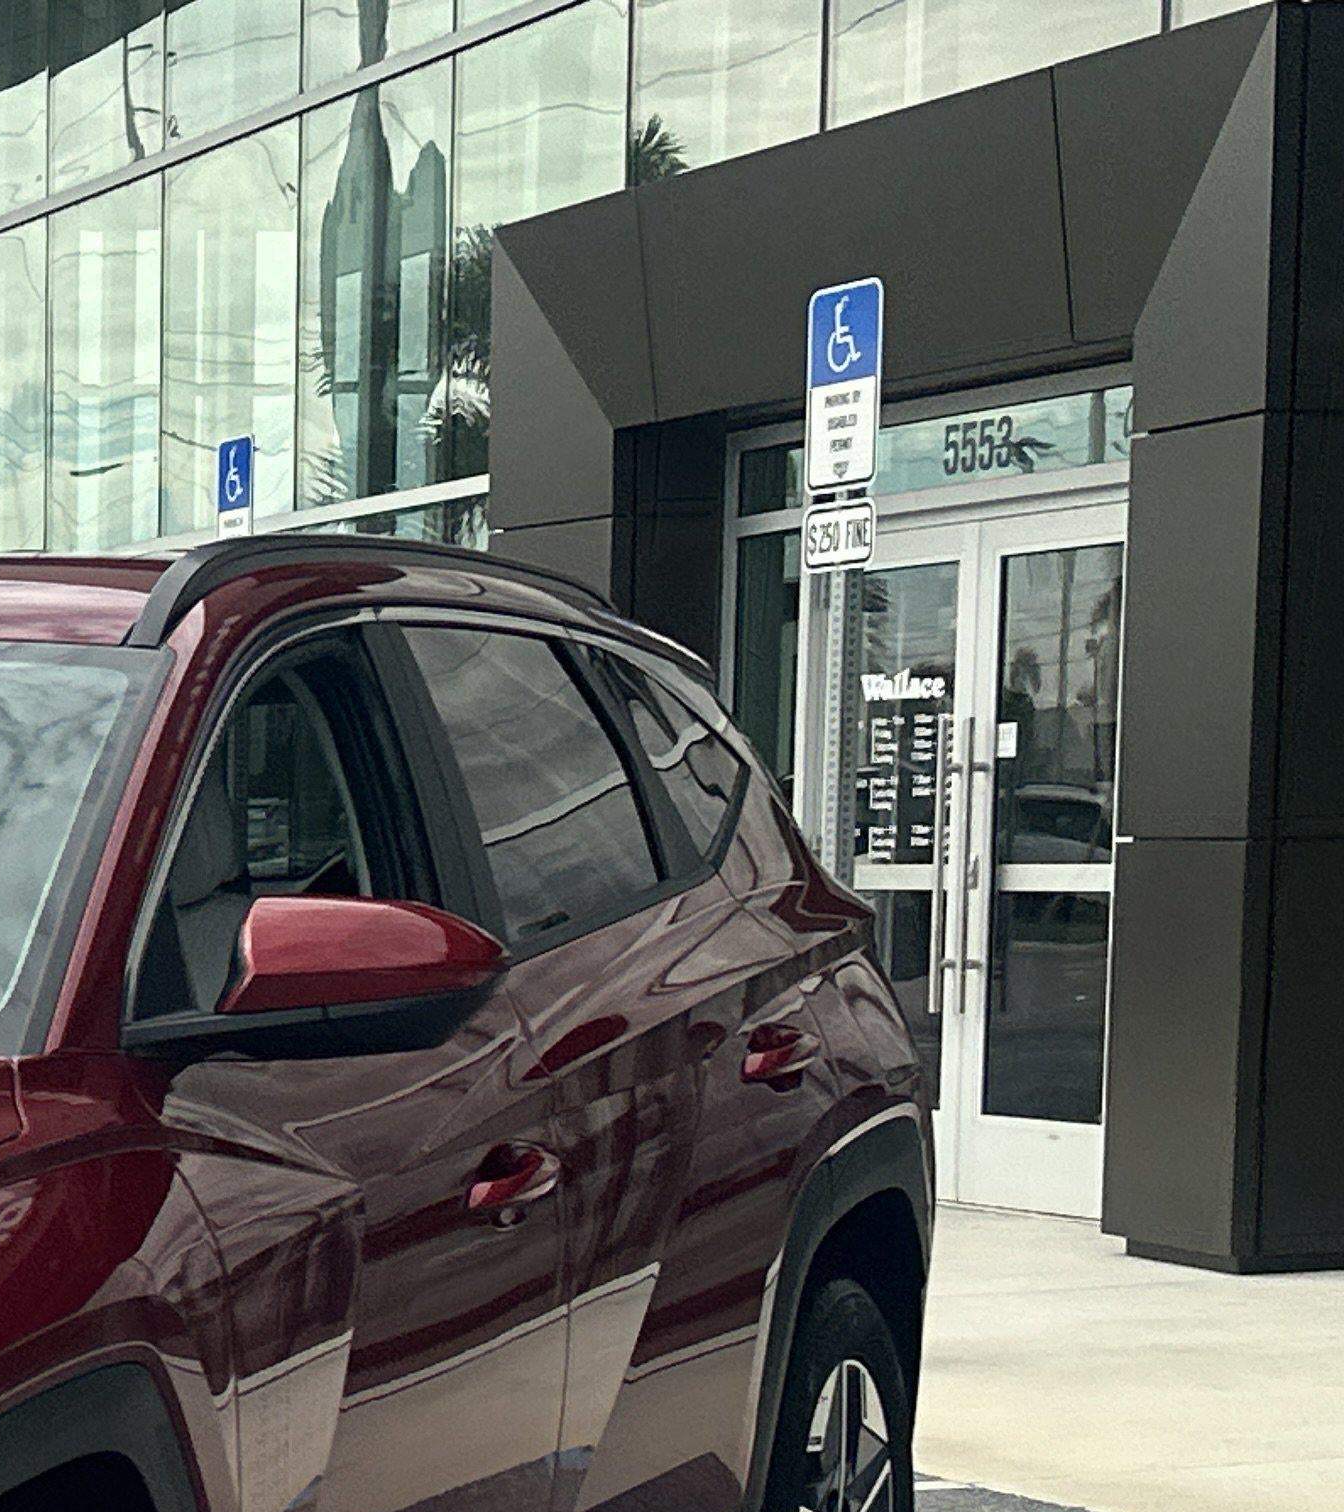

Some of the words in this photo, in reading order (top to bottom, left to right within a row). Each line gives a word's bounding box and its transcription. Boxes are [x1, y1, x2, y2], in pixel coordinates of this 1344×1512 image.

[943, 415, 1013, 476] 5553
[844, 517, 871, 549] FINE
[861, 667, 946, 702] Wallace
